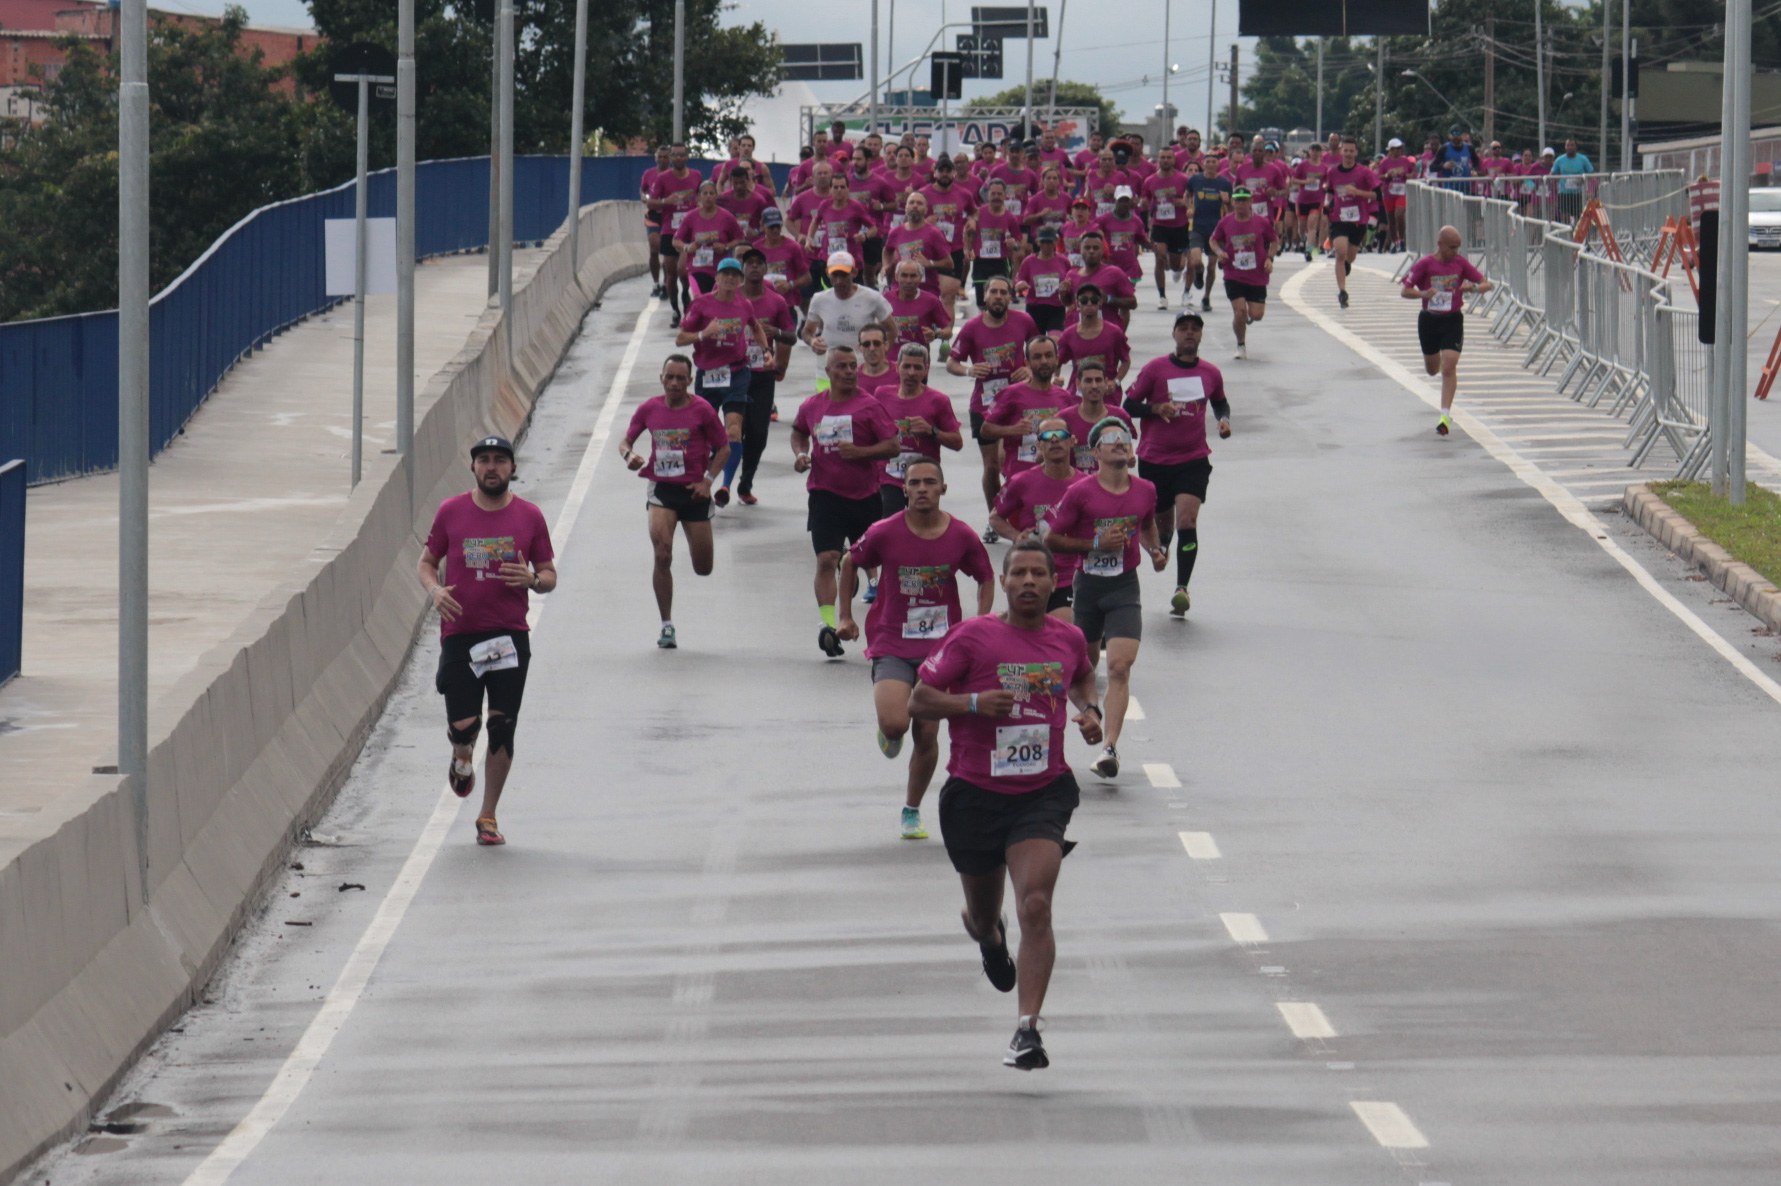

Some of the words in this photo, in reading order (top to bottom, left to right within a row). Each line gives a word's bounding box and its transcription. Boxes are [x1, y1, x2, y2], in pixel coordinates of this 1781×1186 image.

[660, 461, 680, 469] 174
[1093, 556, 1118, 568] 290
[918, 619, 935, 633] 84
[1006, 744, 1043, 763] 208
